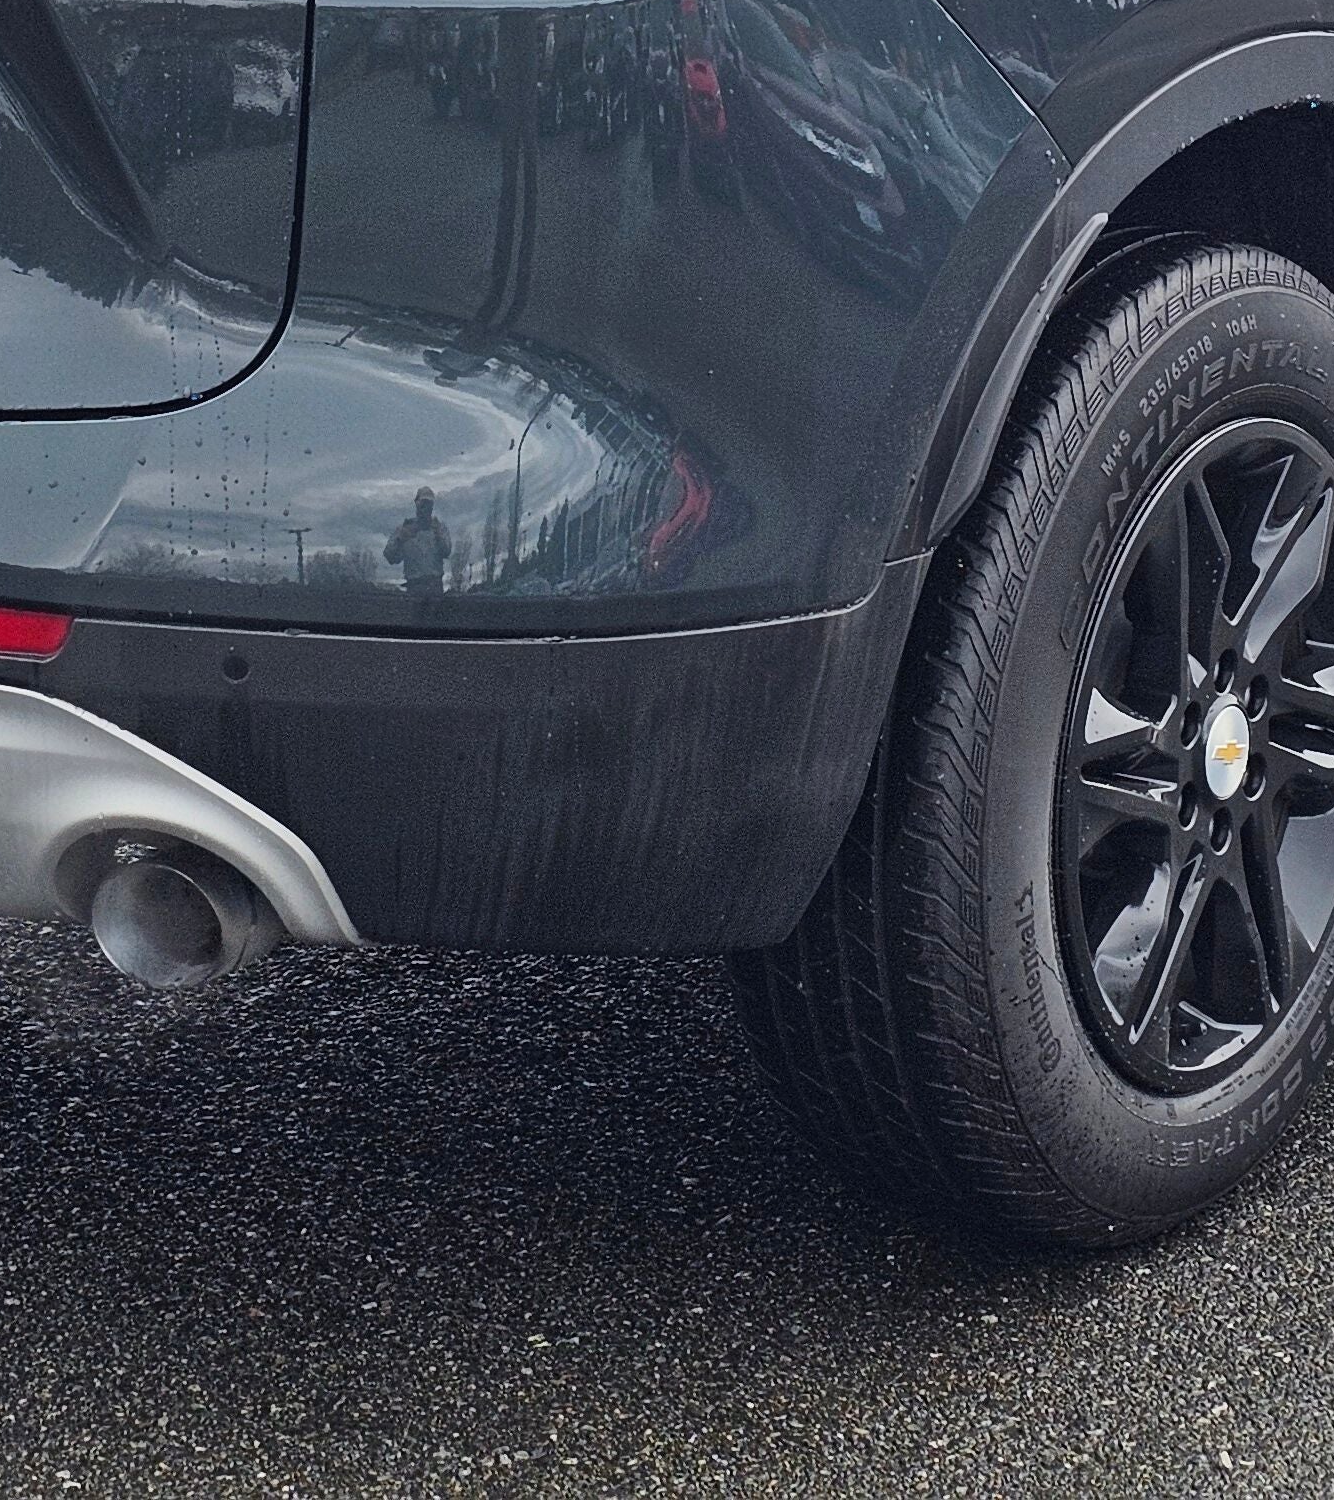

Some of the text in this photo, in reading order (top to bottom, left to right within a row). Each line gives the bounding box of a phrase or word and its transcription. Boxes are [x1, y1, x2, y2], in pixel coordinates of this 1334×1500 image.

[1099, 427, 1133, 478] M+S
[1224, 313, 1259, 340] 106H
[1016, 908, 1062, 1074] Continental
